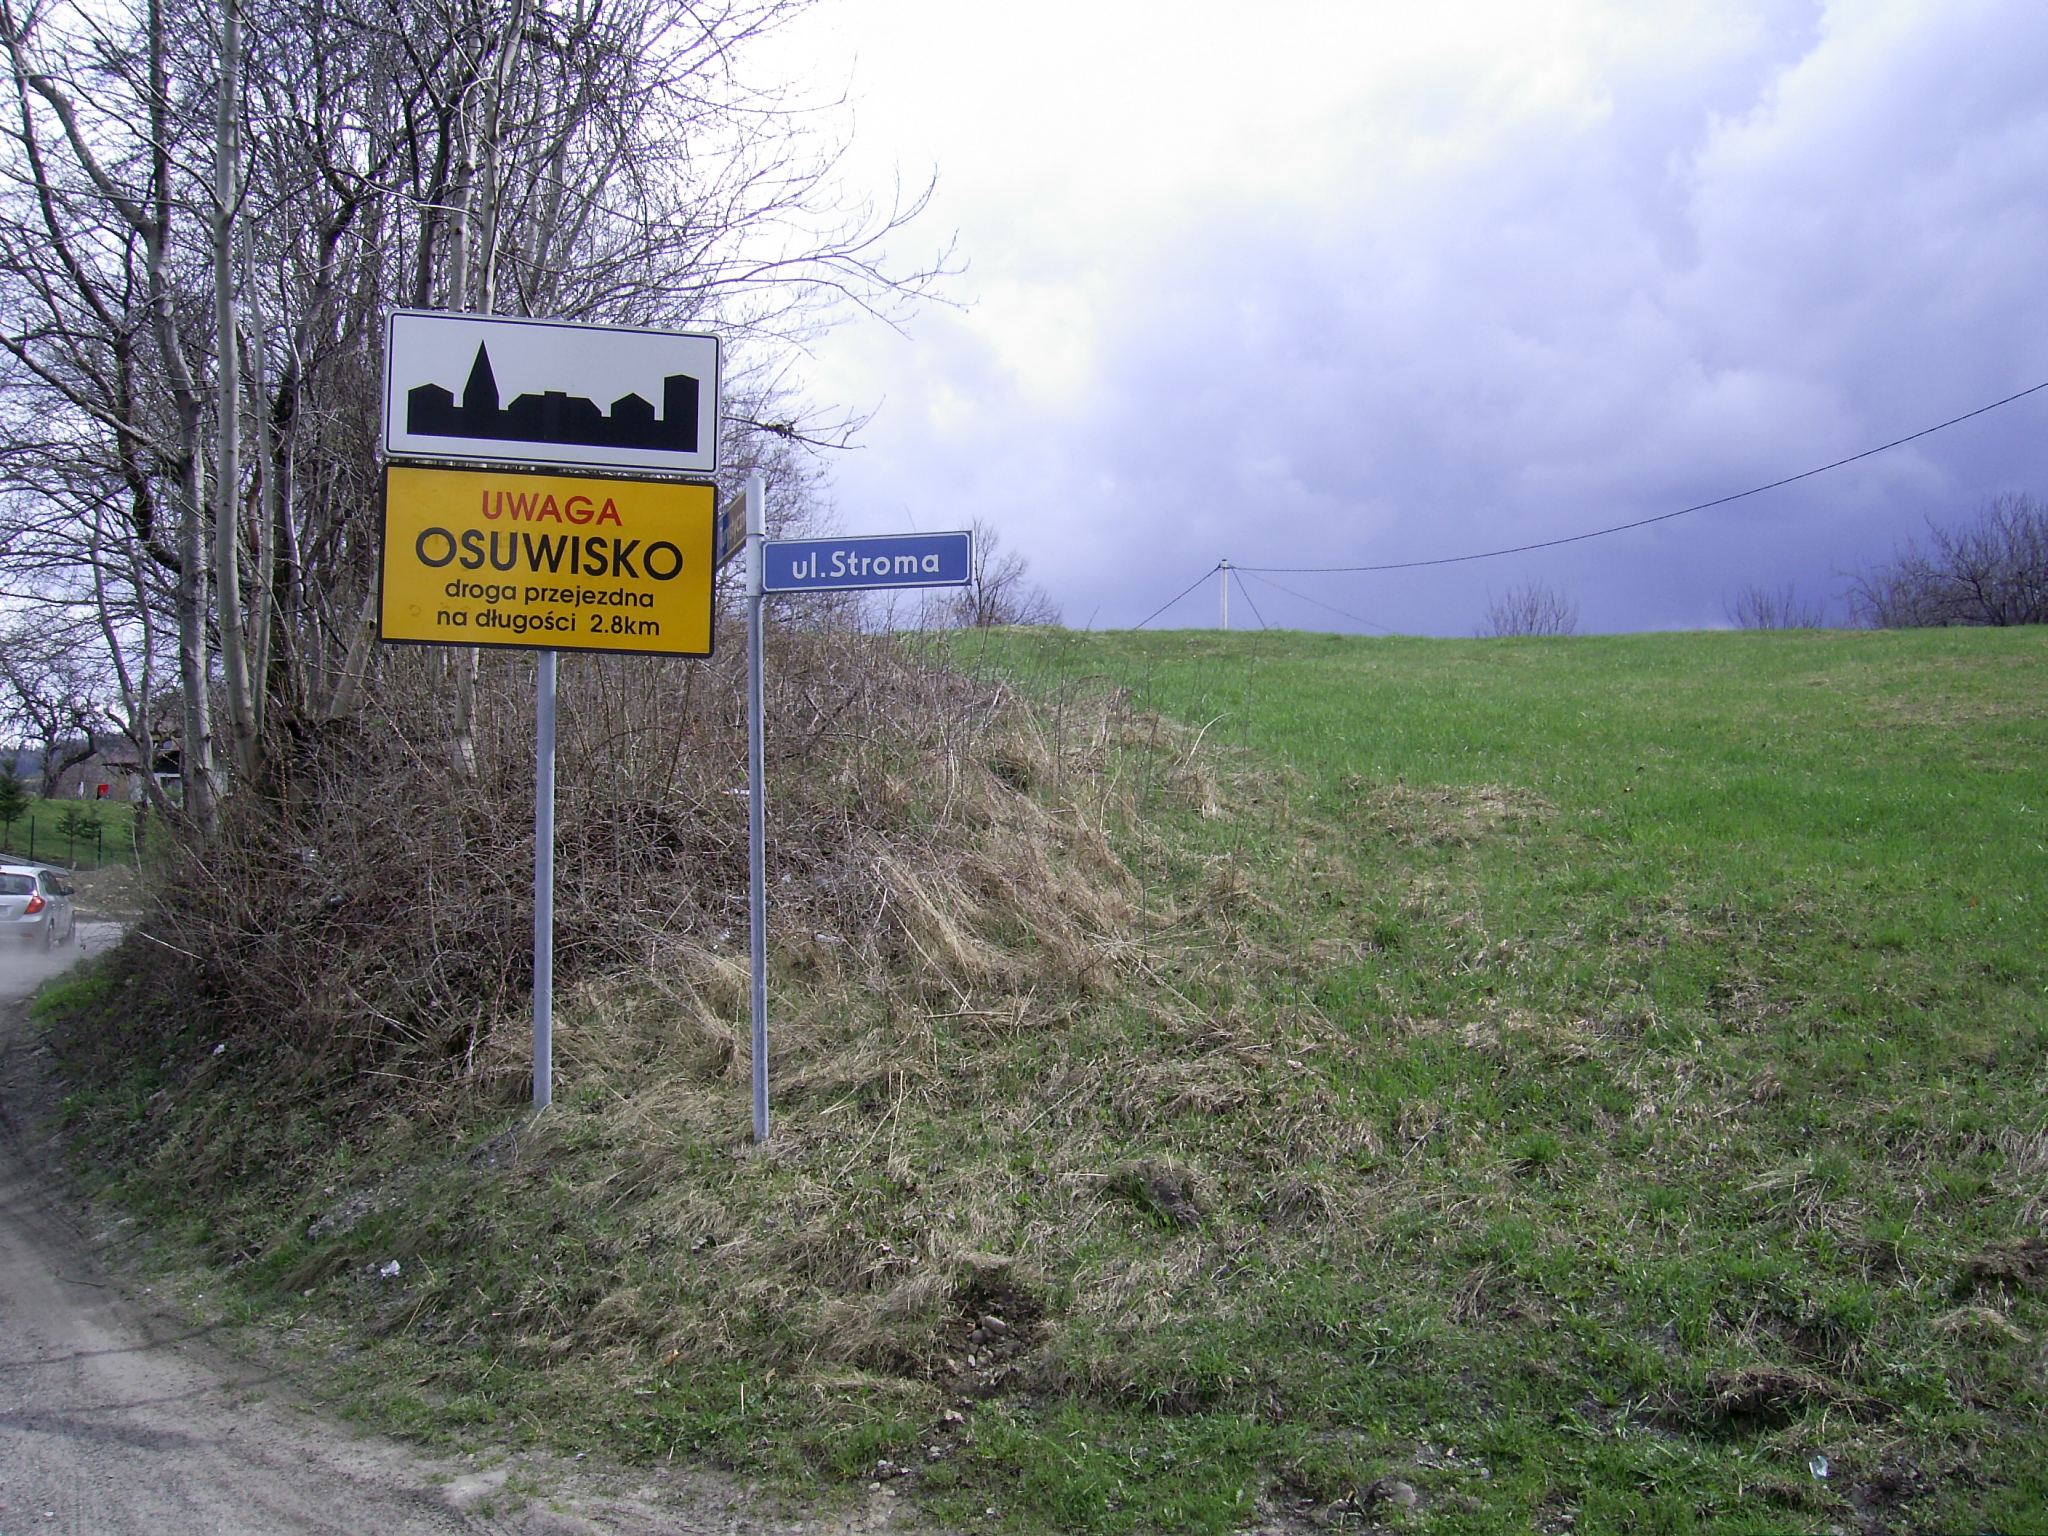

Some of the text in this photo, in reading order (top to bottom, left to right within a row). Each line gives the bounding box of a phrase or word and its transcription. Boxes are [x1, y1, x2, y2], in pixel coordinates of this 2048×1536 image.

[482, 490, 622, 527] UWAGA
[416, 527, 683, 580] OSUWISKO
[445, 579, 654, 608] droga przejezdna
[437, 608, 660, 636] na długości 2.8km
